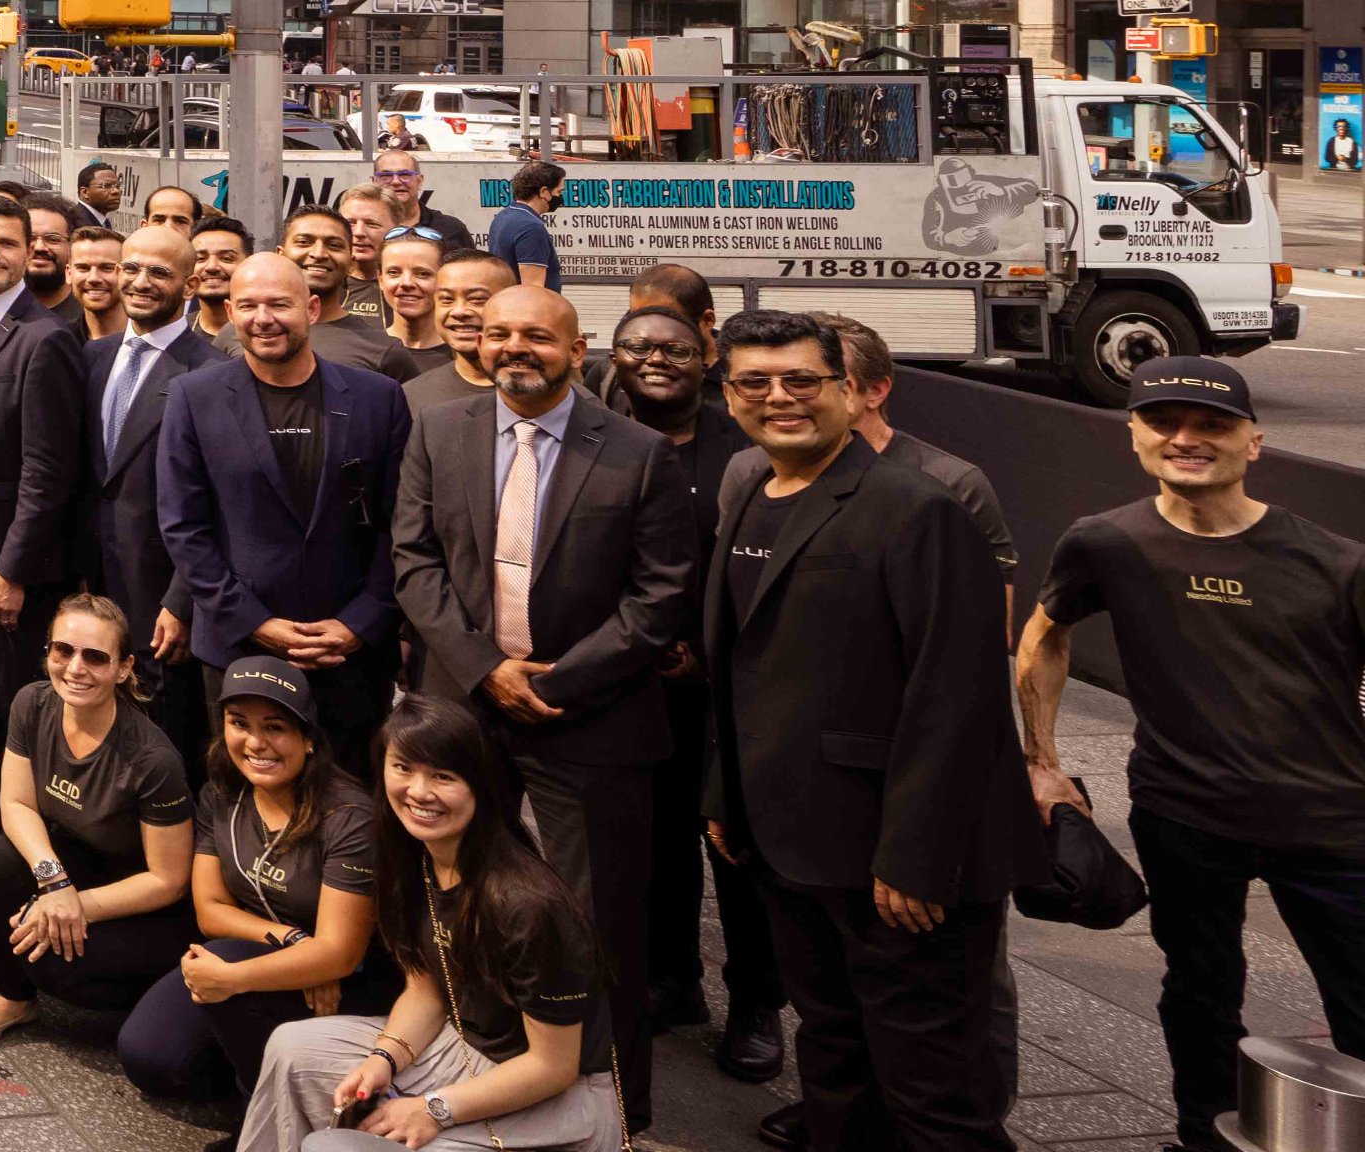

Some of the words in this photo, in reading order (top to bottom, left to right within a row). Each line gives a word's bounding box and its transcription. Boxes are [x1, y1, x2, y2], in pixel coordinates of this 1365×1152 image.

[1126, 0, 1147, 8] ONE
[1159, 0, 1181, 8] WAY
[480, 179, 609, 208] MISNEOUS
[612, 180, 715, 209] FABRICATION
[719, 181, 731, 209] &
[733, 180, 855, 210] INSTALLATIONS
[572, 217, 646, 228] STRUCTURAL
[648, 217, 710, 229] ALUMINUM
[713, 217, 721, 229] &
[724, 217, 752, 230] CAST
[756, 217, 784, 230] IRON
[786, 217, 838, 230] WELDING
[1134, 221, 1150, 232] 137
[1153, 221, 1189, 233] LIBERTY
[1192, 221, 1214, 233] AVE.
[588, 235, 633, 248] MILLING
[649, 236, 689, 248] POWER
[693, 236, 729, 249] PRESS
[731, 236, 780, 249] SERVICE
[784, 236, 791, 250] &
[793, 237, 831, 250] ANGLE
[834, 237, 882, 251] ROLLING
[1128, 235, 1175, 247] BROOKLYN,
[1176, 235, 1189, 246] NY
[1190, 235, 1214, 247] 11212
[559, 256, 595, 266] RTIFIED
[598, 256, 616, 266] DOB
[619, 257, 658, 266] WELDER
[1125, 252, 1220, 262] 718-810-4082
[559, 265, 595, 275] RTIFIED
[598, 266, 617, 275] PIPE
[778, 259, 1003, 279] 718-810-4082
[353, 302, 377, 312] LCID
[1212, 312, 1239, 320] USDOT#
[1243, 320, 1268, 328] 17,950
[1143, 378, 1231, 391] LUCID
[732, 547, 771, 557] LUC
[1190, 576, 1243, 596] LCID
[1186, 591, 1222, 604] Nasdaq
[1223, 595, 1252, 607] Listed
[233, 671, 296, 691] LUCID
[51, 774, 80, 800] LCID
[45, 785, 65, 803] Nasdaq
[65, 795, 83, 810] Listed
